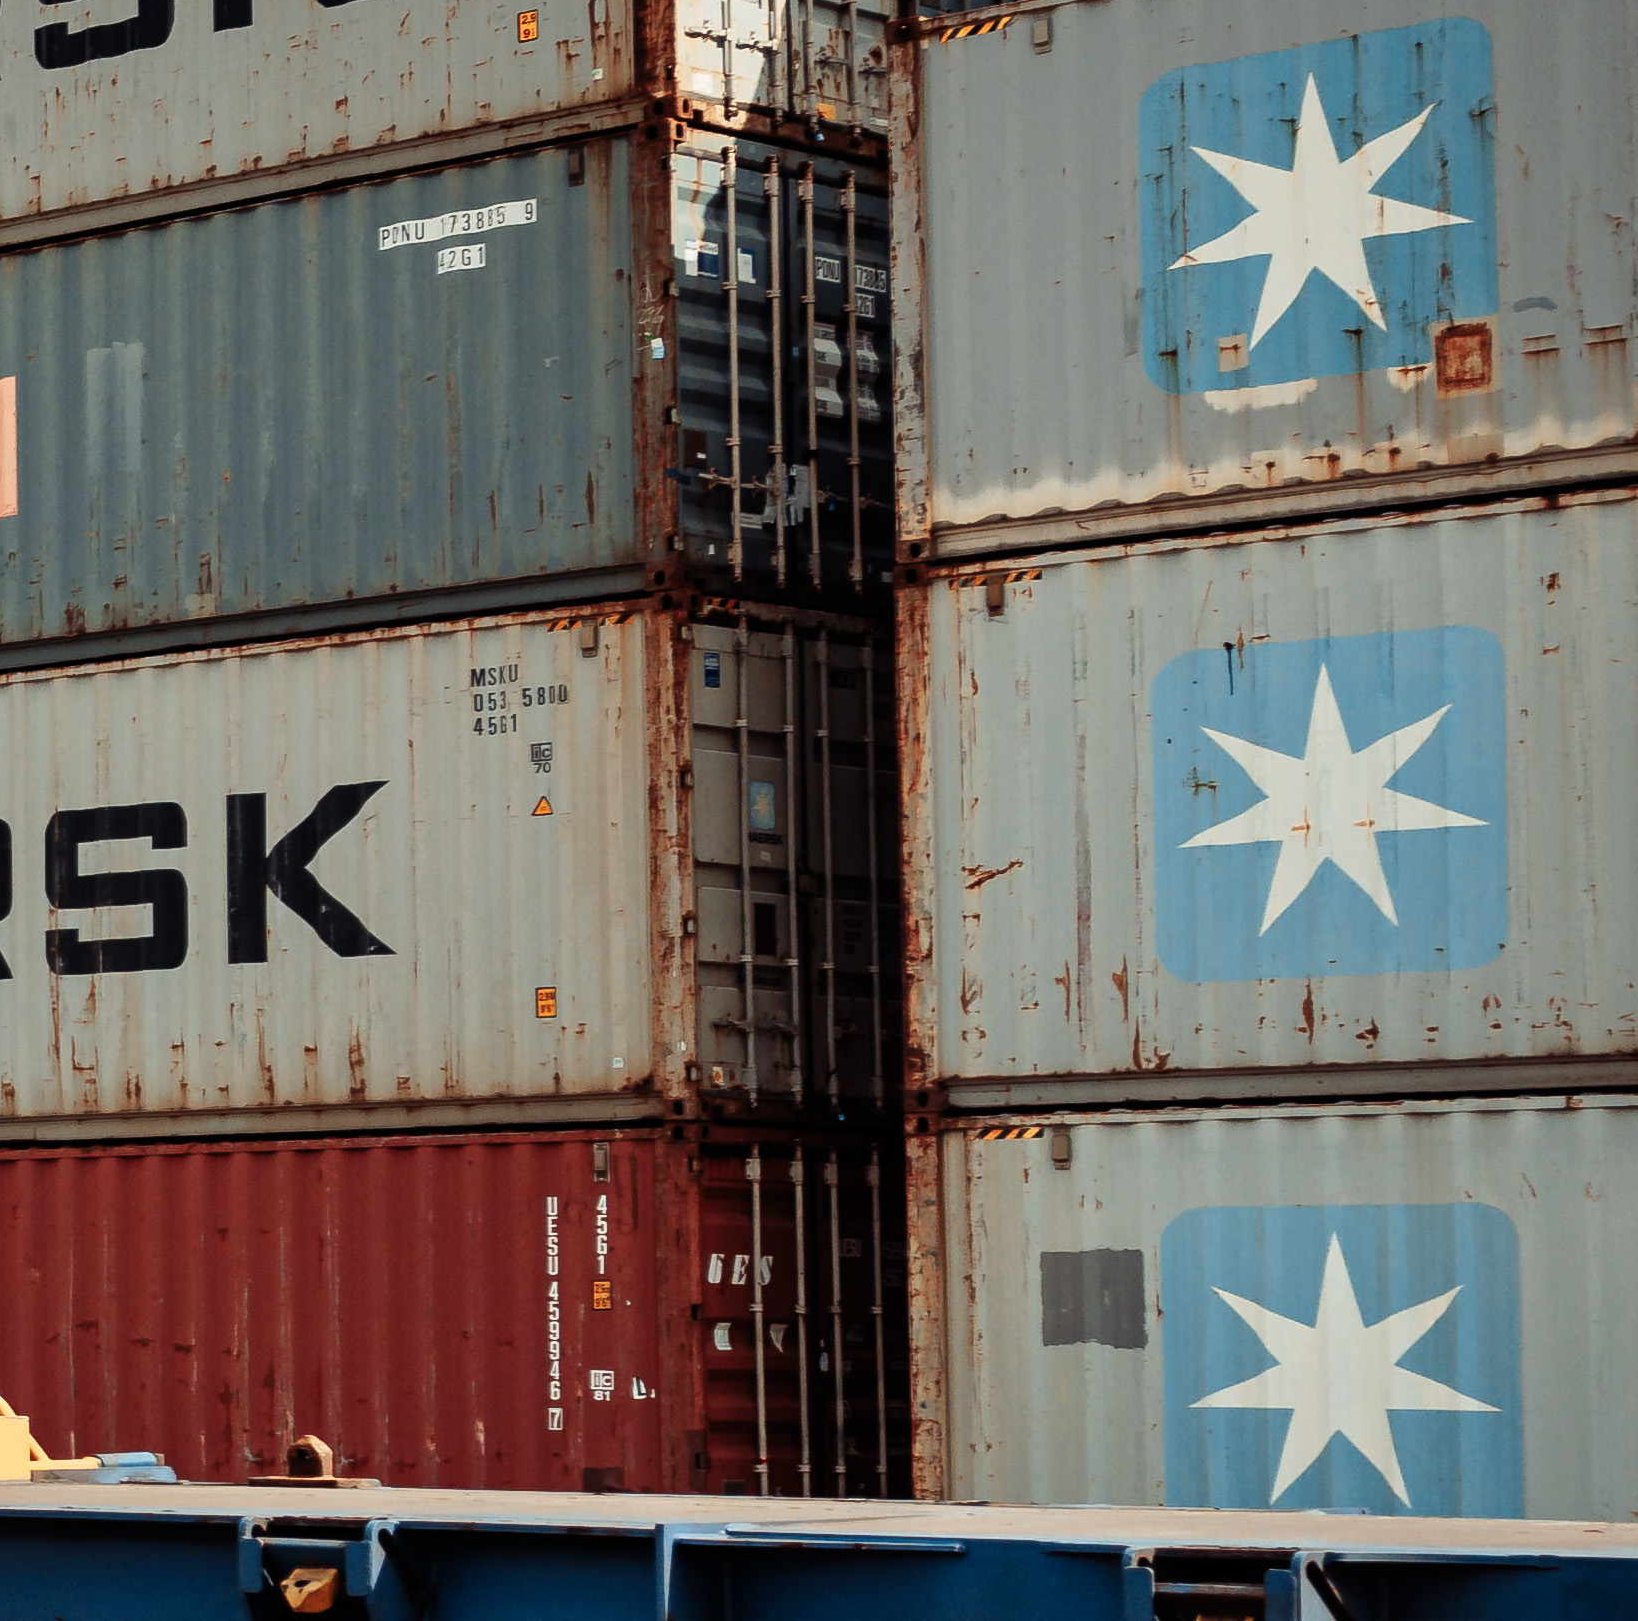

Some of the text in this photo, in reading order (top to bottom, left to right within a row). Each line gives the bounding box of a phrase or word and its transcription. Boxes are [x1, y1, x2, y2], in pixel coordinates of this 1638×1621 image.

[381, 222, 425, 248] PONU
[525, 202, 534, 221] 9
[857, 294, 875, 317] 2G1
[470, 664, 519, 688] MSKU
[533, 762, 552, 774] 70
[596, 1194, 609, 1275] 45G1
[593, 1390, 611, 1402] 81
[551, 1409, 561, 1428] 7
